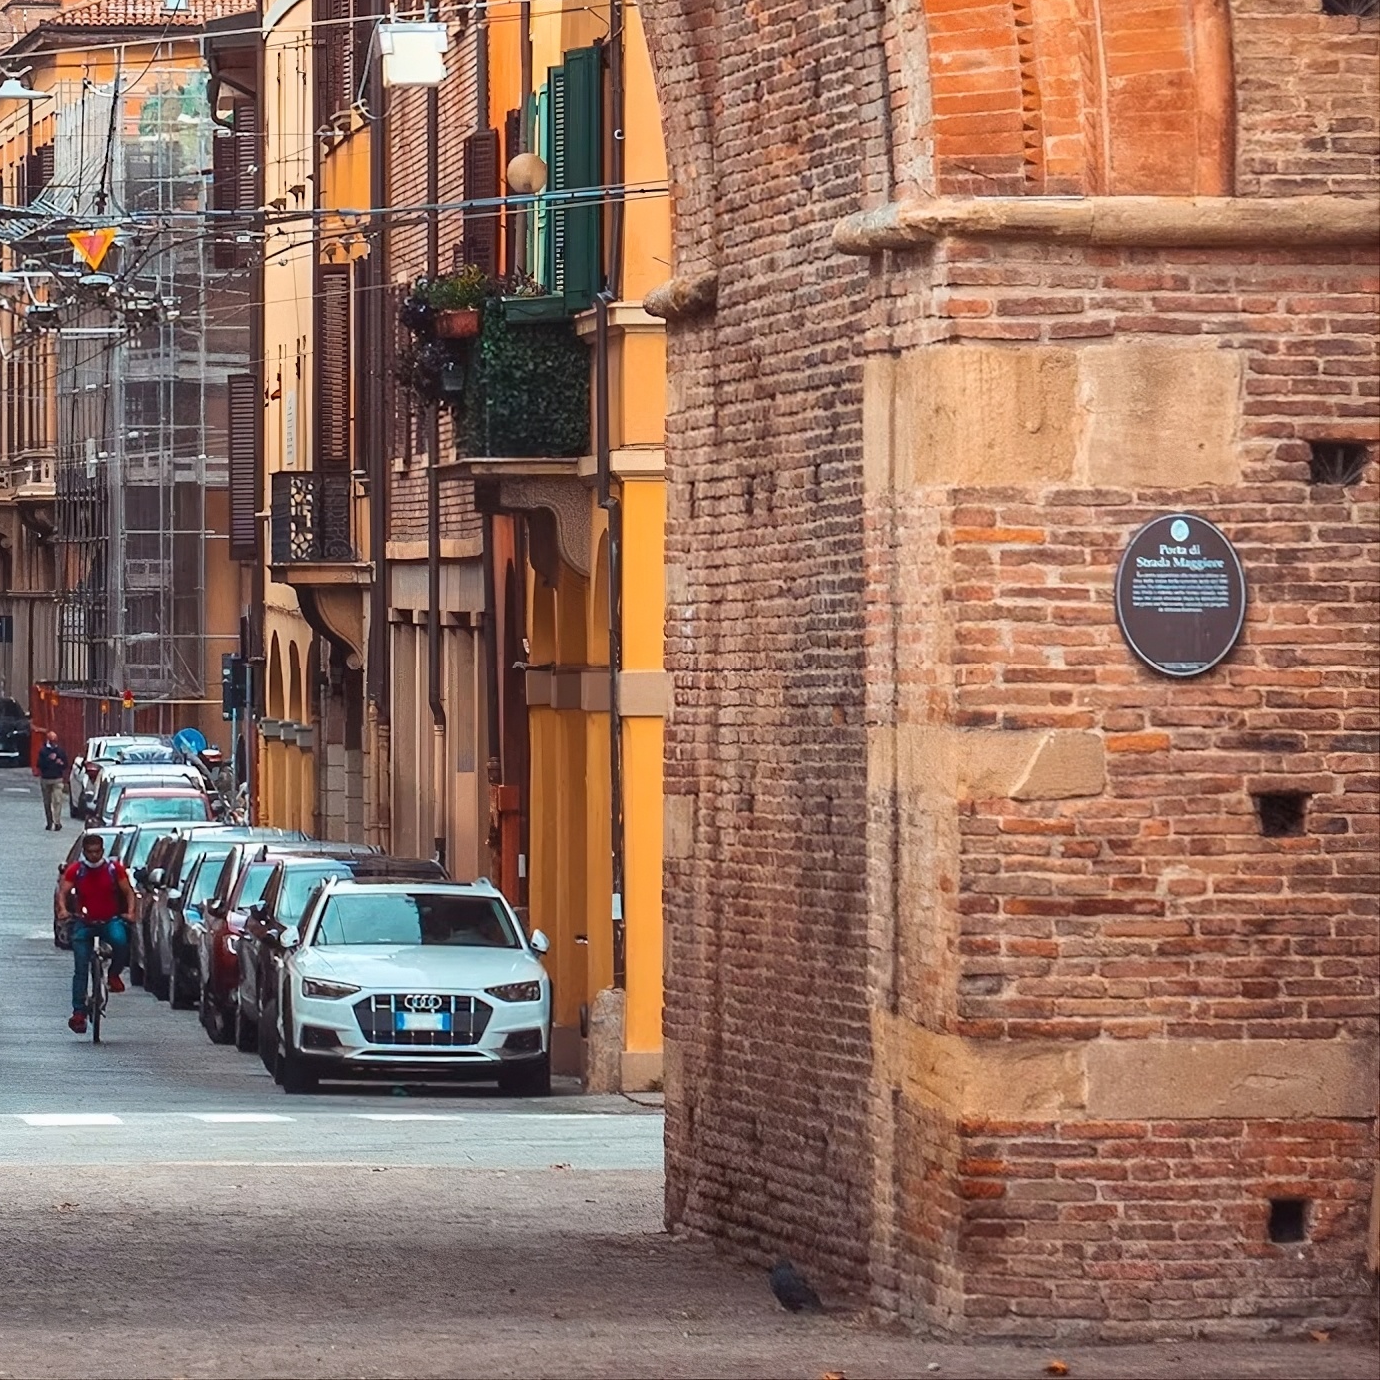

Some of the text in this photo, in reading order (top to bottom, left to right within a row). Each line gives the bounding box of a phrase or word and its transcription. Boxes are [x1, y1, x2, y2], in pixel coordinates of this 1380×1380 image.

[1159, 544, 1201, 555] Porta di
[1136, 556, 1225, 571] Strada Maggiore
